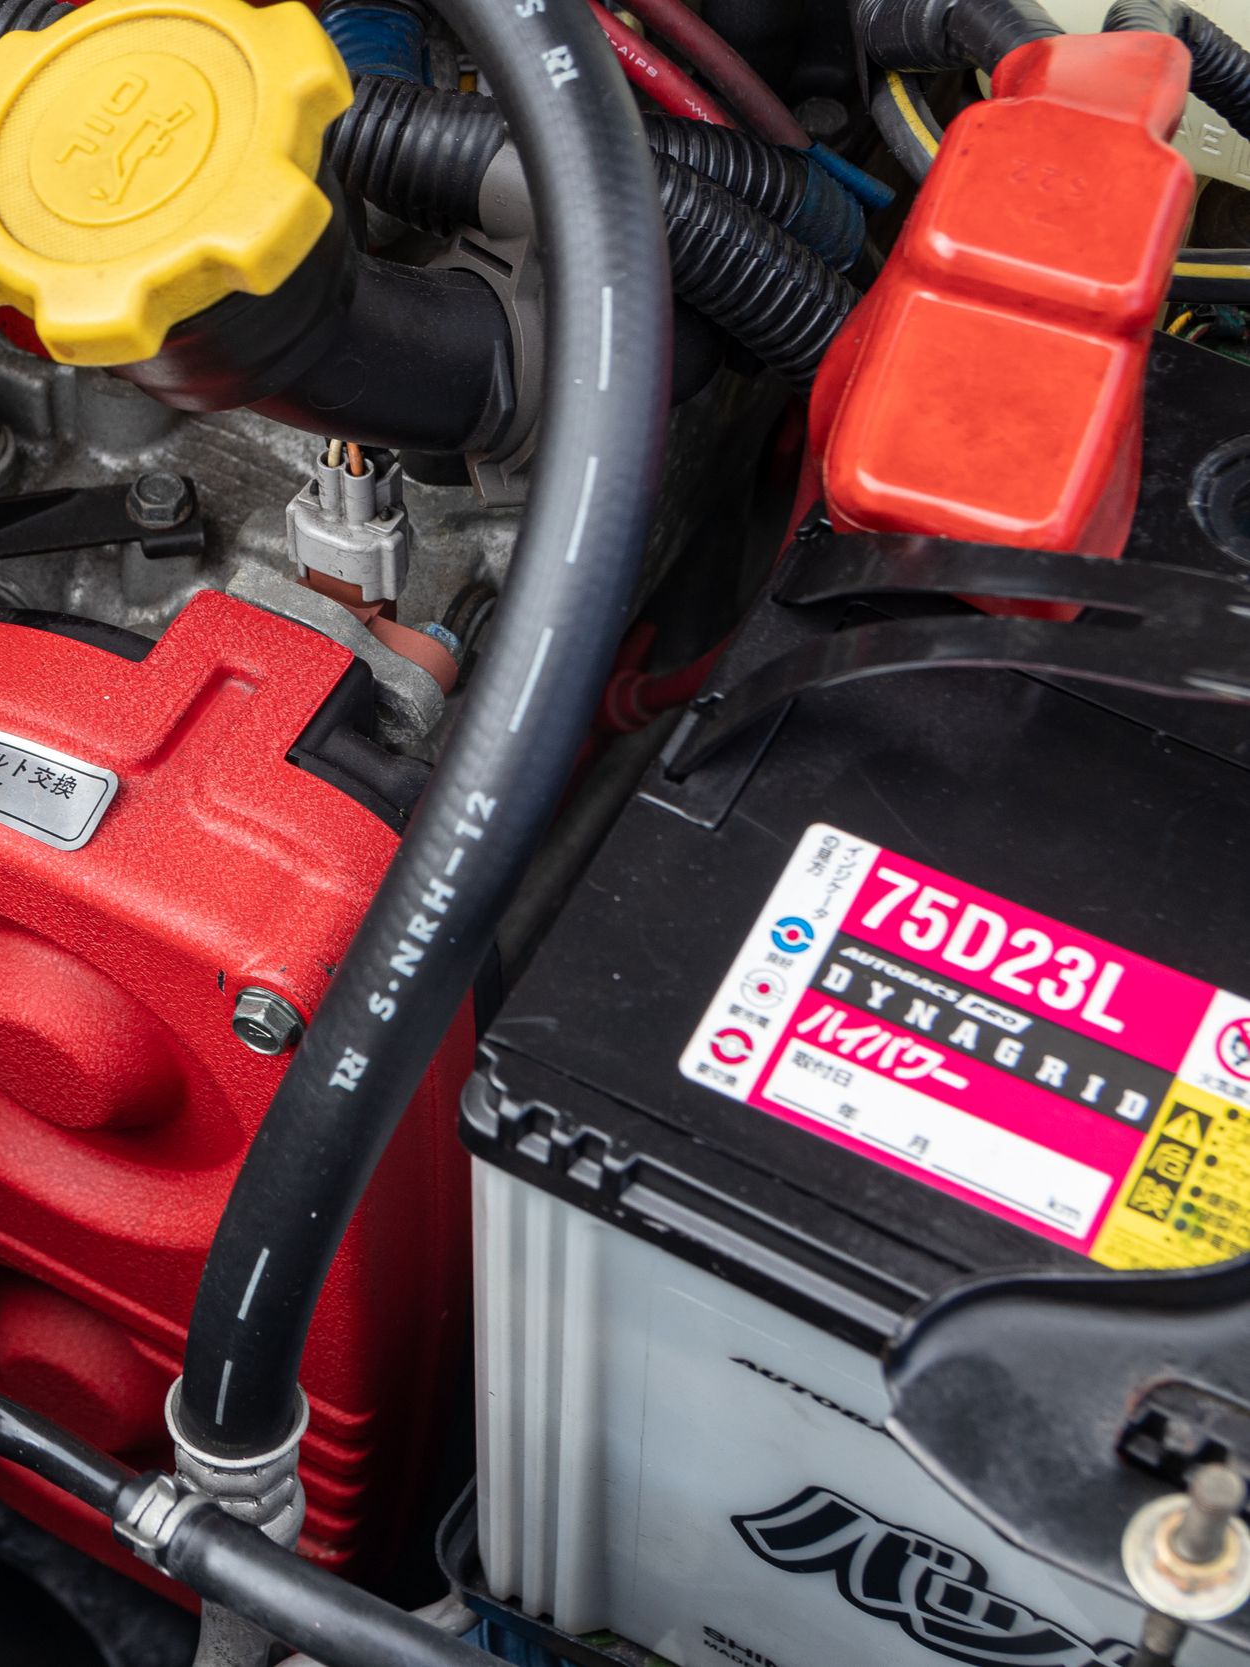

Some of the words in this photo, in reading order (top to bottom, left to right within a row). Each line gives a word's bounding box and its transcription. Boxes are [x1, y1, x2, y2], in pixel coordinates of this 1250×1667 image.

[55, 72, 149, 165] OIL
[839, 946, 961, 1003] AUTOBACS
[861, 866, 1125, 1033] 75D23L
[790, 1050, 854, 1089] 取付日
[796, 1005, 970, 1090] ハイパワー
[821, 962, 1150, 1122] DYNAGRID
[907, 1134, 931, 1156] 月
[1047, 1195, 1082, 1220] km
[1129, 1142, 1192, 1221] 危険
